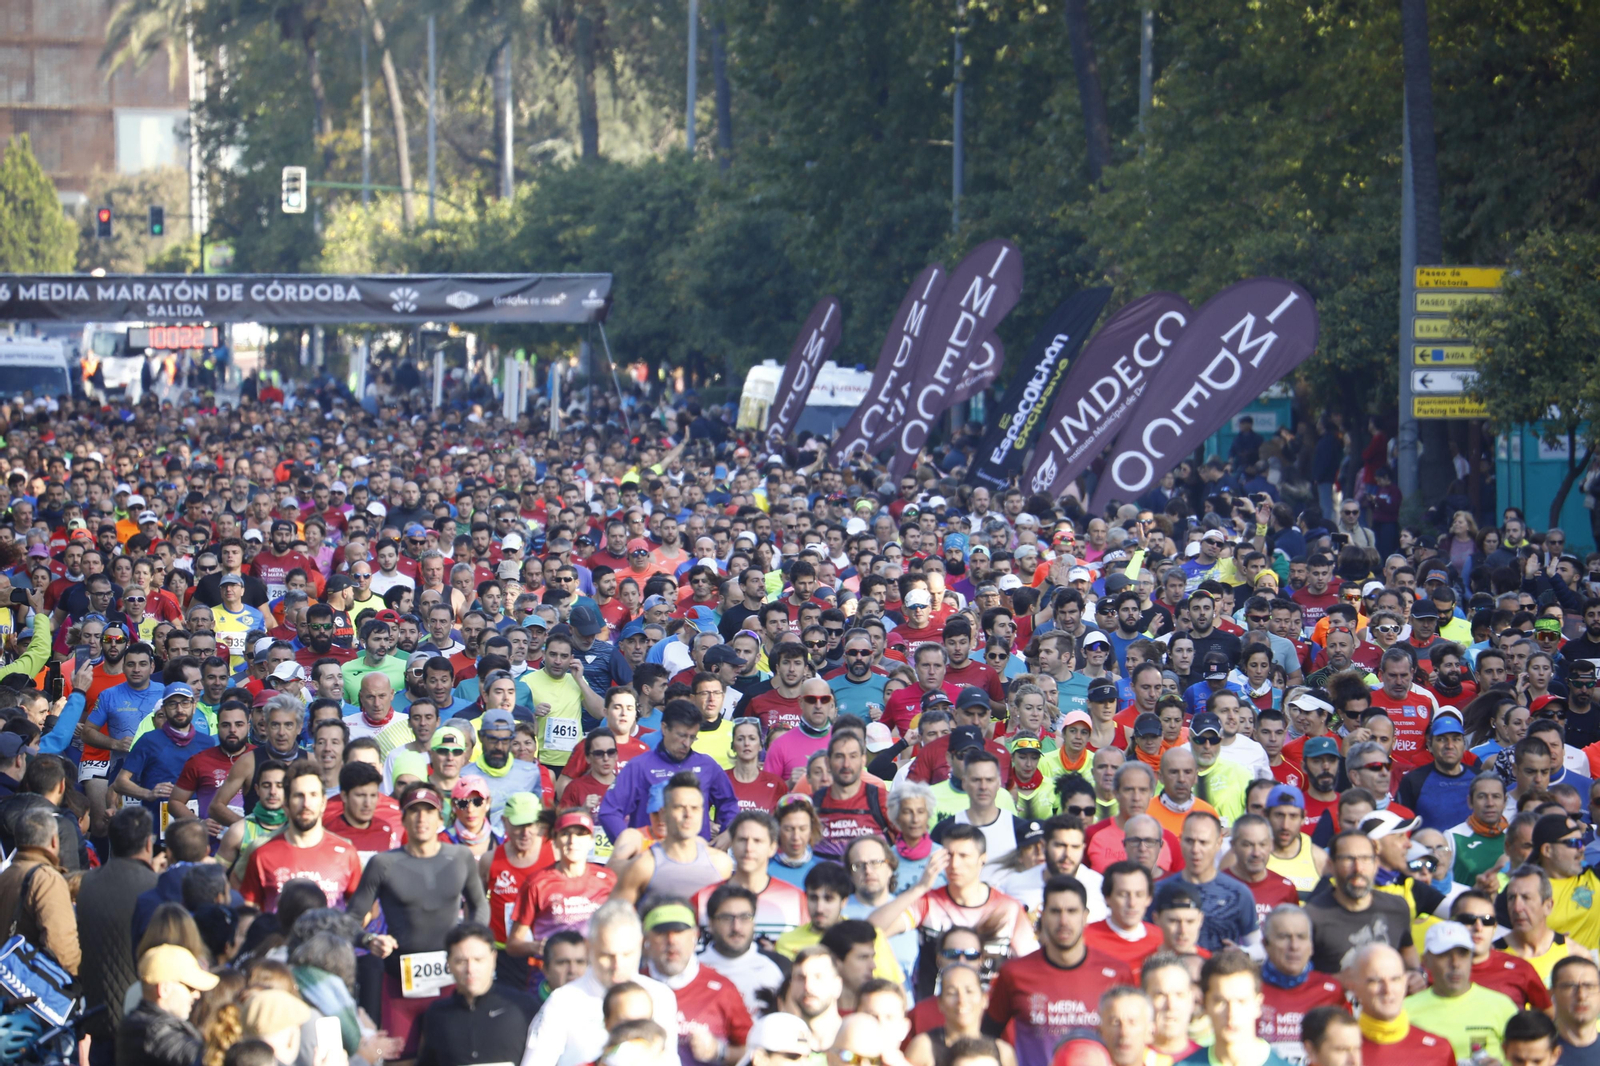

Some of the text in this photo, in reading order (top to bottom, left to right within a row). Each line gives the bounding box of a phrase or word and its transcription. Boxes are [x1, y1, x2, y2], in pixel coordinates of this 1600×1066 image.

[1419, 269, 1447, 277] Paseo
[1433, 279, 1468, 287] Victoria
[18, 283, 90, 301] MEDIA
[97, 279, 208, 301] MARATÓN
[216, 283, 244, 301] DE
[250, 279, 362, 302] CÓRDOBA
[1419, 298, 1446, 306] PASEO
[146, 303, 204, 317] SALIDA
[1050, 310, 1187, 455] IMDECO
[1111, 290, 1299, 493] IMDECO
[1417, 407, 1447, 415] Parking
[1066, 435, 1095, 464] Instituto
[1092, 402, 1127, 438] Municipal
[552, 724, 578, 737] 4615
[1393, 738, 1418, 752] Vélez
[82, 759, 109, 769] 3429
[830, 819, 858, 828] MEDIA
[830, 826, 874, 838] MARATÓN
[1047, 1000, 1087, 1013] MEDIA
